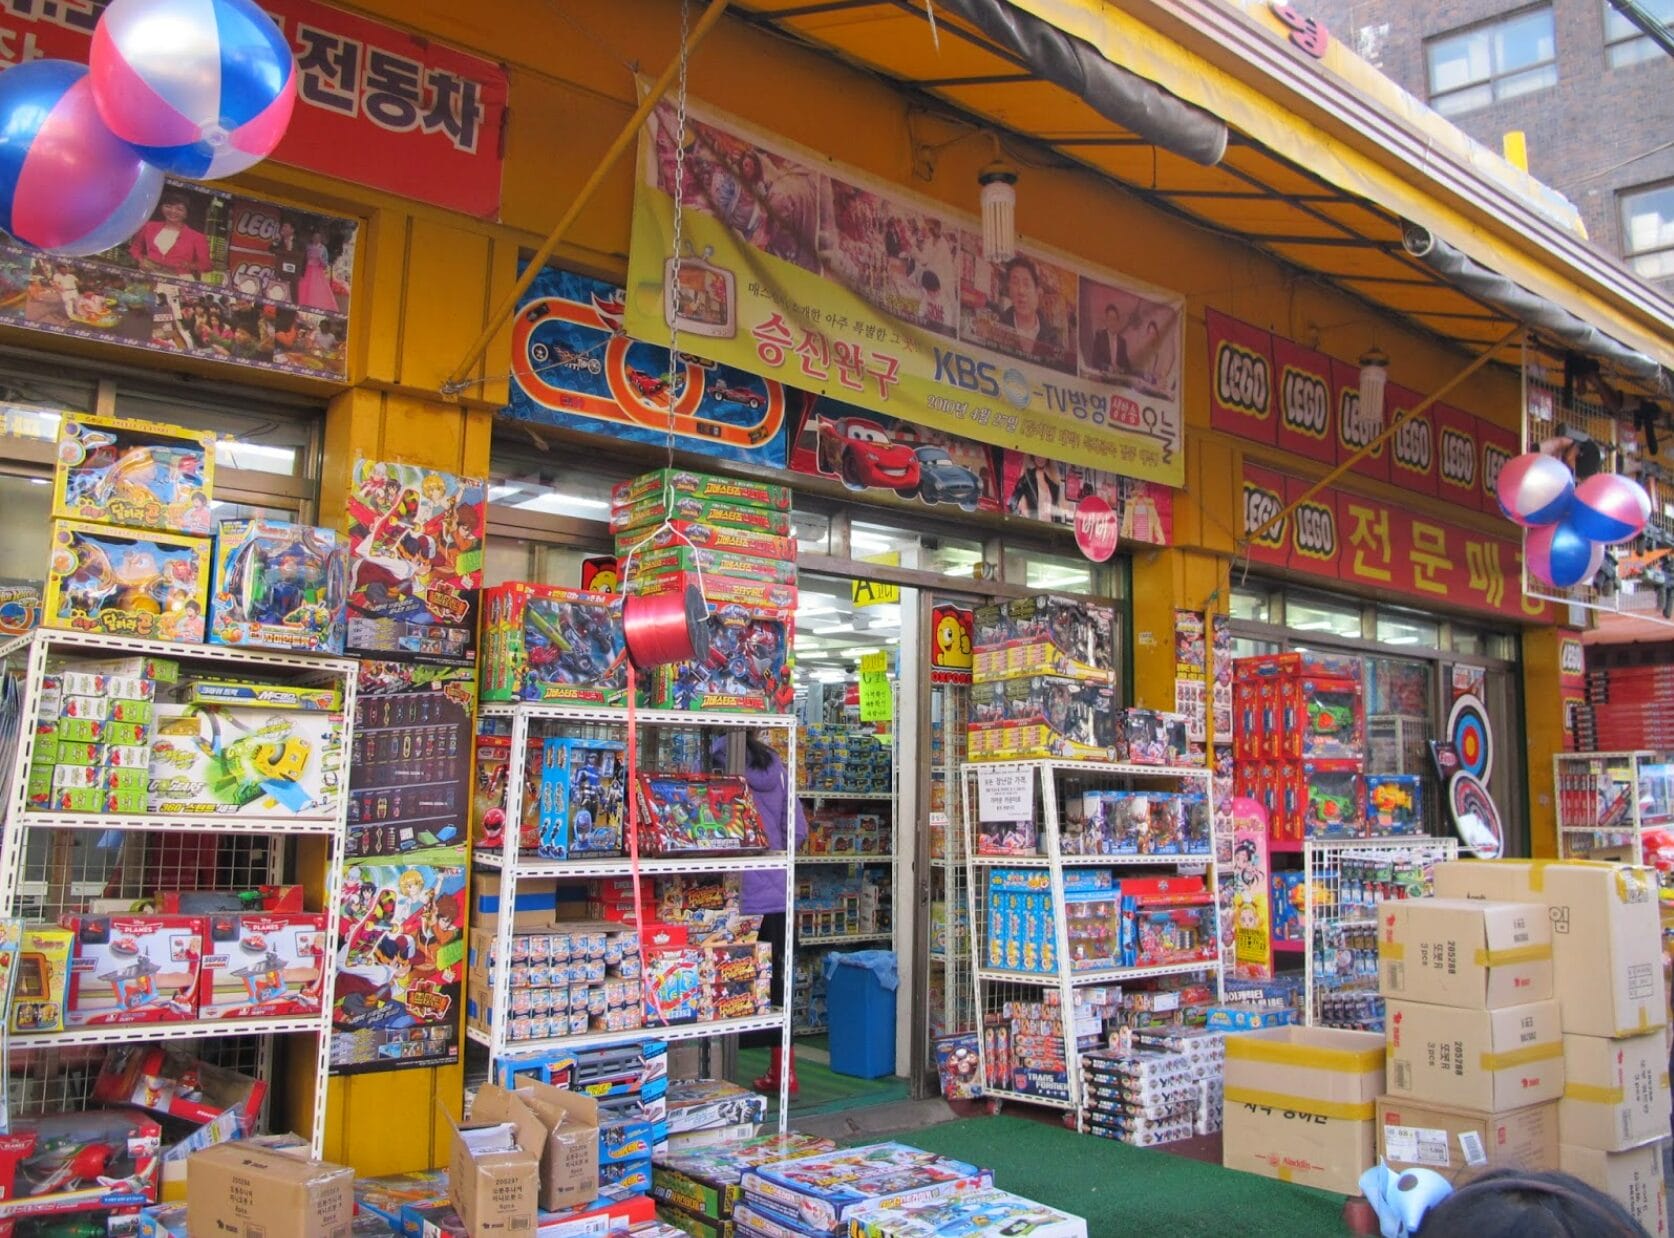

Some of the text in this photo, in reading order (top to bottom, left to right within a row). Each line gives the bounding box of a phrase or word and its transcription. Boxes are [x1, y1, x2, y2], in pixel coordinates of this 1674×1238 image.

[297, 22, 486, 155] 전동차
[752, 312, 900, 399] 승진완구
[826, 312, 848, 330] 아주
[933, 346, 1000, 398] KBS
[1219, 346, 1268, 412] LEGO
[1284, 371, 1328, 432] LEGO
[1443, 431, 1473, 484] LEGO
[1296, 505, 1334, 554] LEGO
